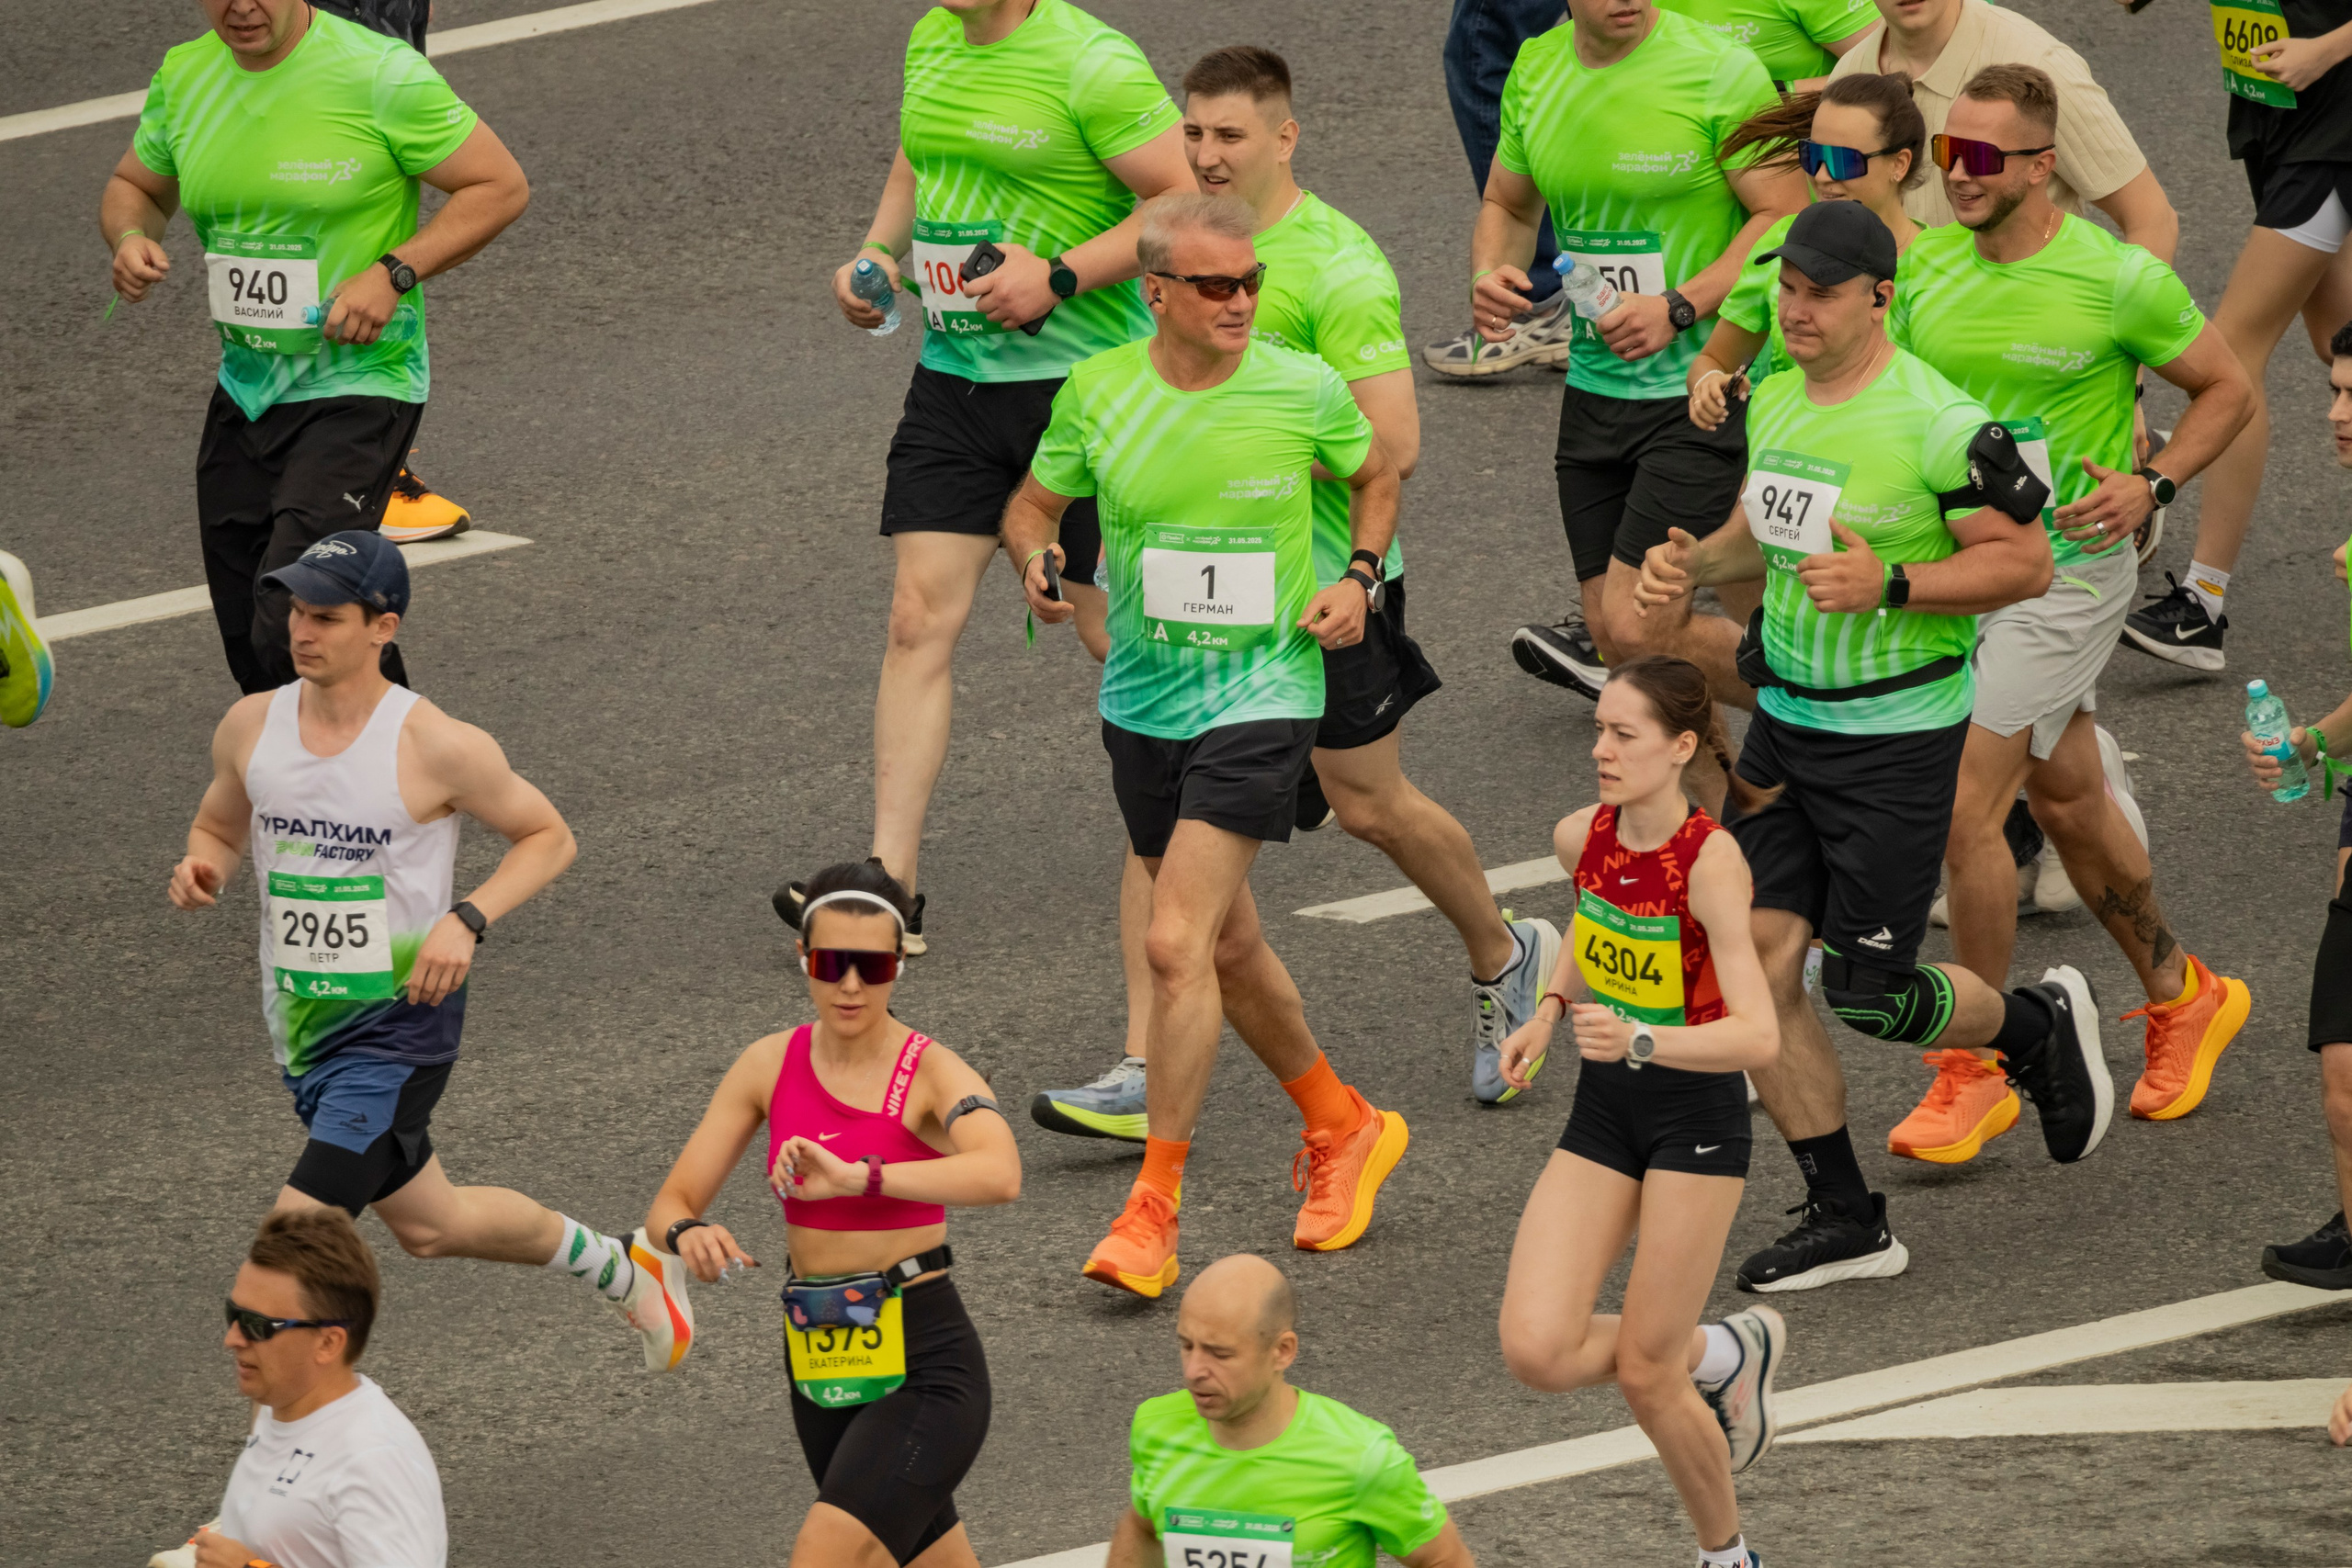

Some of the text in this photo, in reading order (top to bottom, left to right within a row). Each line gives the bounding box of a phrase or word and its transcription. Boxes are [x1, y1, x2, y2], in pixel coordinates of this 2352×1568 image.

[2224, 17, 2278, 53] 6608
[973, 119, 1019, 136] зелёный
[966, 130, 1013, 145] марафон
[1618, 150, 1672, 162] зелёный
[277, 158, 333, 170] зелёный
[1612, 162, 1668, 174] марафон
[270, 171, 328, 183] марафон
[229, 267, 288, 306] 940
[234, 305, 284, 320] ВАСИЛИЙ
[2010, 343, 2067, 358] зелёный
[2002, 353, 2061, 367] марафон
[1227, 475, 1281, 489] зелёный
[1762, 485, 1814, 527] 947
[1228, 536, 1262, 545] 31.05.2025
[1769, 525, 1800, 541] СЕРГЕЙ
[1201, 565, 1216, 600] 1
[1183, 602, 1234, 615] ГЕРМАН
[258, 814, 391, 845] УРАЛХИМ
[282, 909, 369, 949] 2965
[309, 952, 339, 964] ПЕТР
[1585, 934, 1663, 986] 4304
[1604, 976, 1638, 996] ИРИНА
[886, 1032, 929, 1118] NIKE PRO
[809, 1355, 873, 1370] ЕКАТЕРИНА
